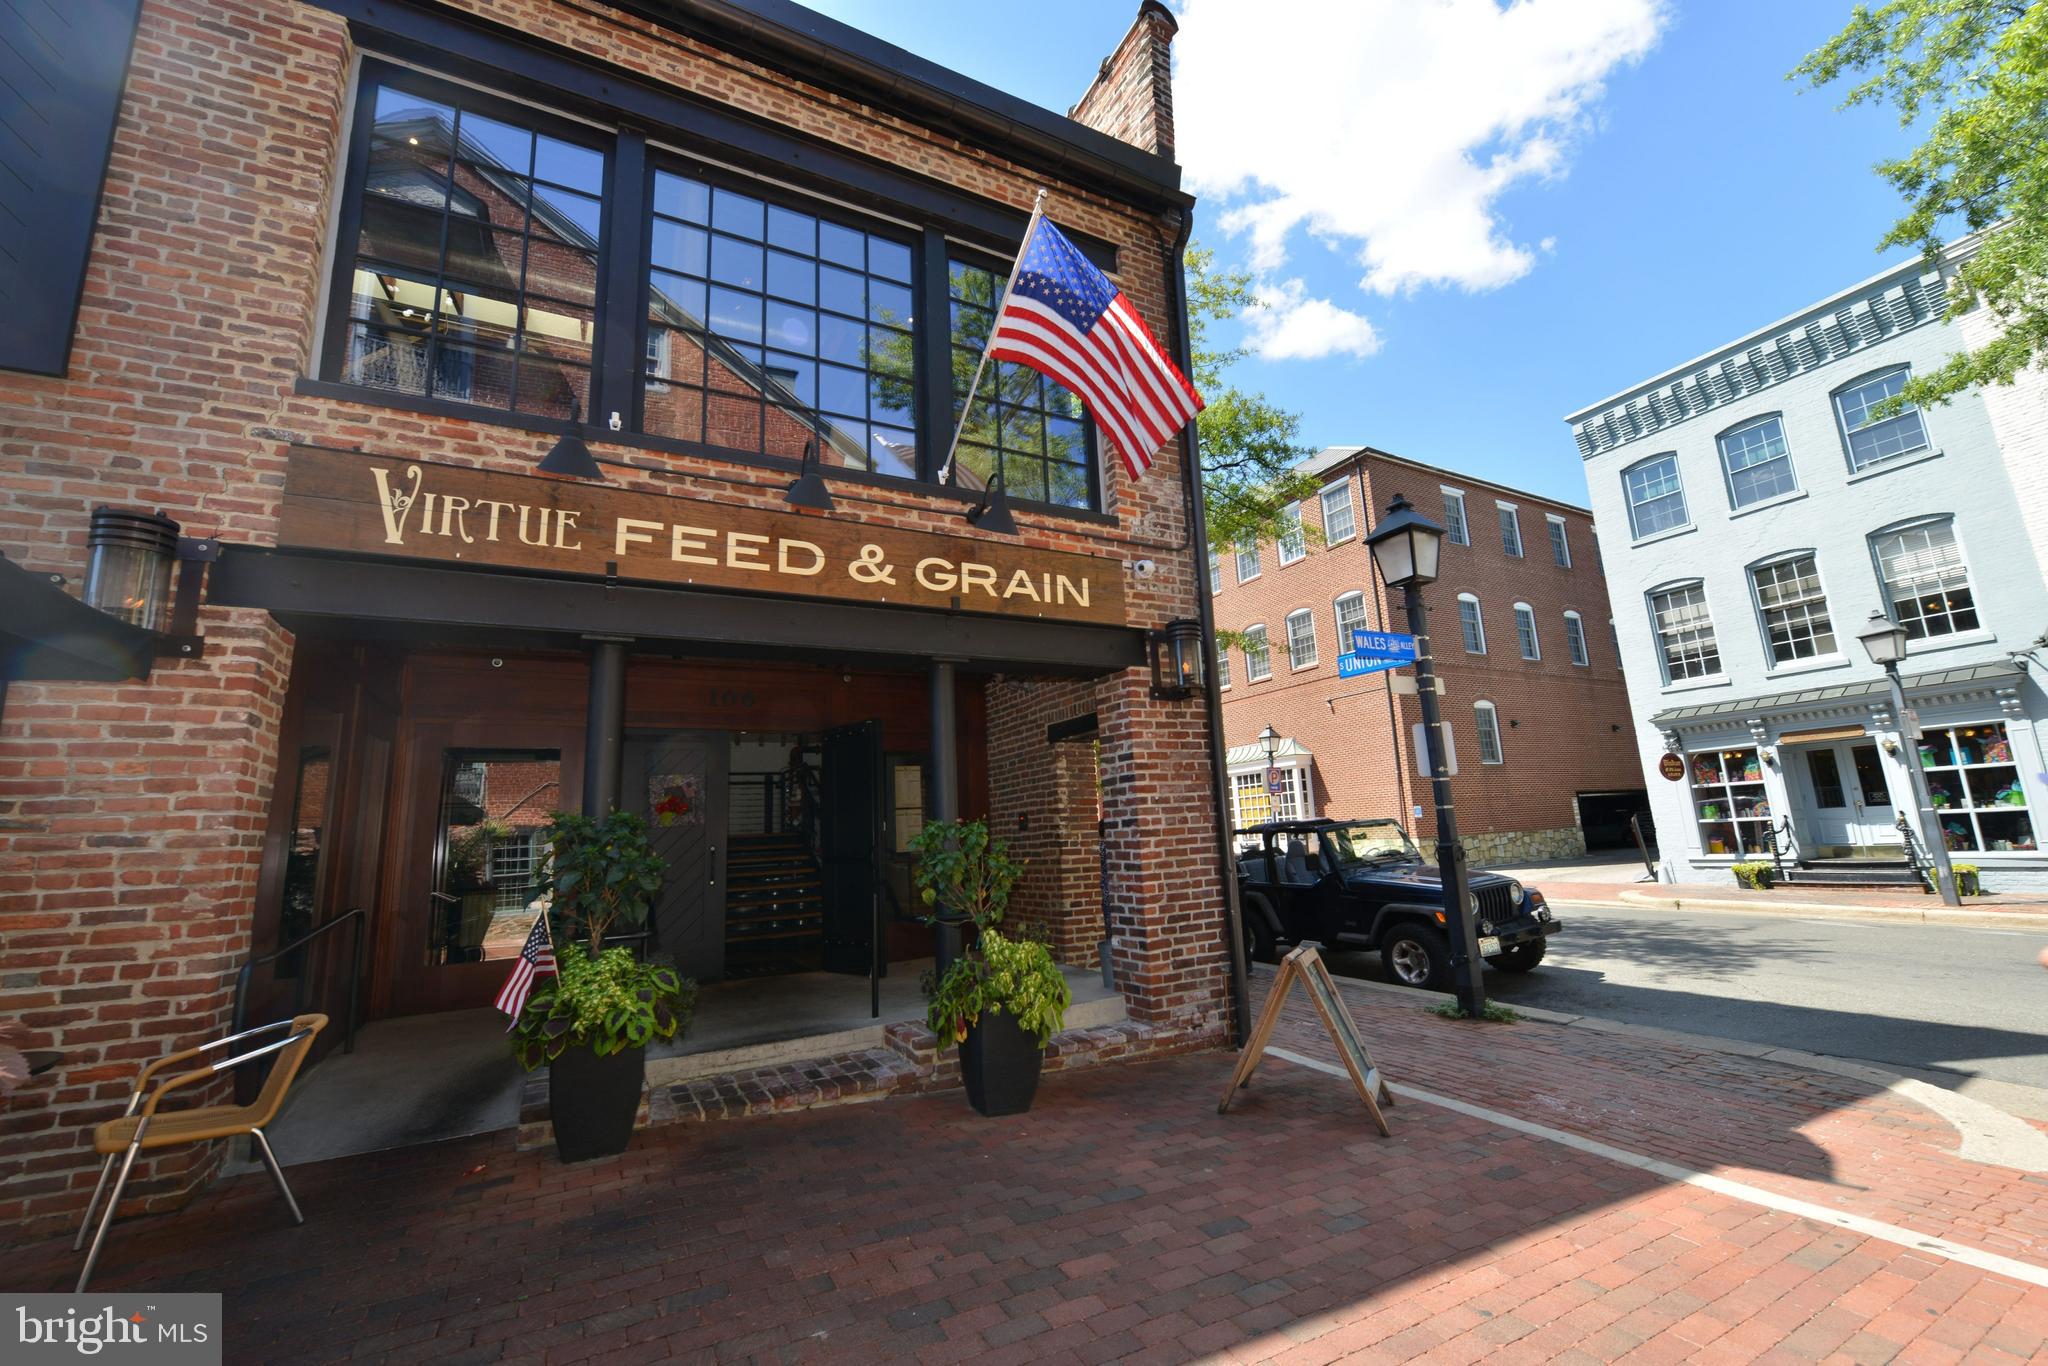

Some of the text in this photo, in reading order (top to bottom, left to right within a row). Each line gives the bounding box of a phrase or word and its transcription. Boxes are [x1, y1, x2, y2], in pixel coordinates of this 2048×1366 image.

[369, 464, 1091, 608] VIRTUE FEED & GRAIN
[1355, 635, 1386, 650] WALES
[1345, 657, 1382, 672] UNION
